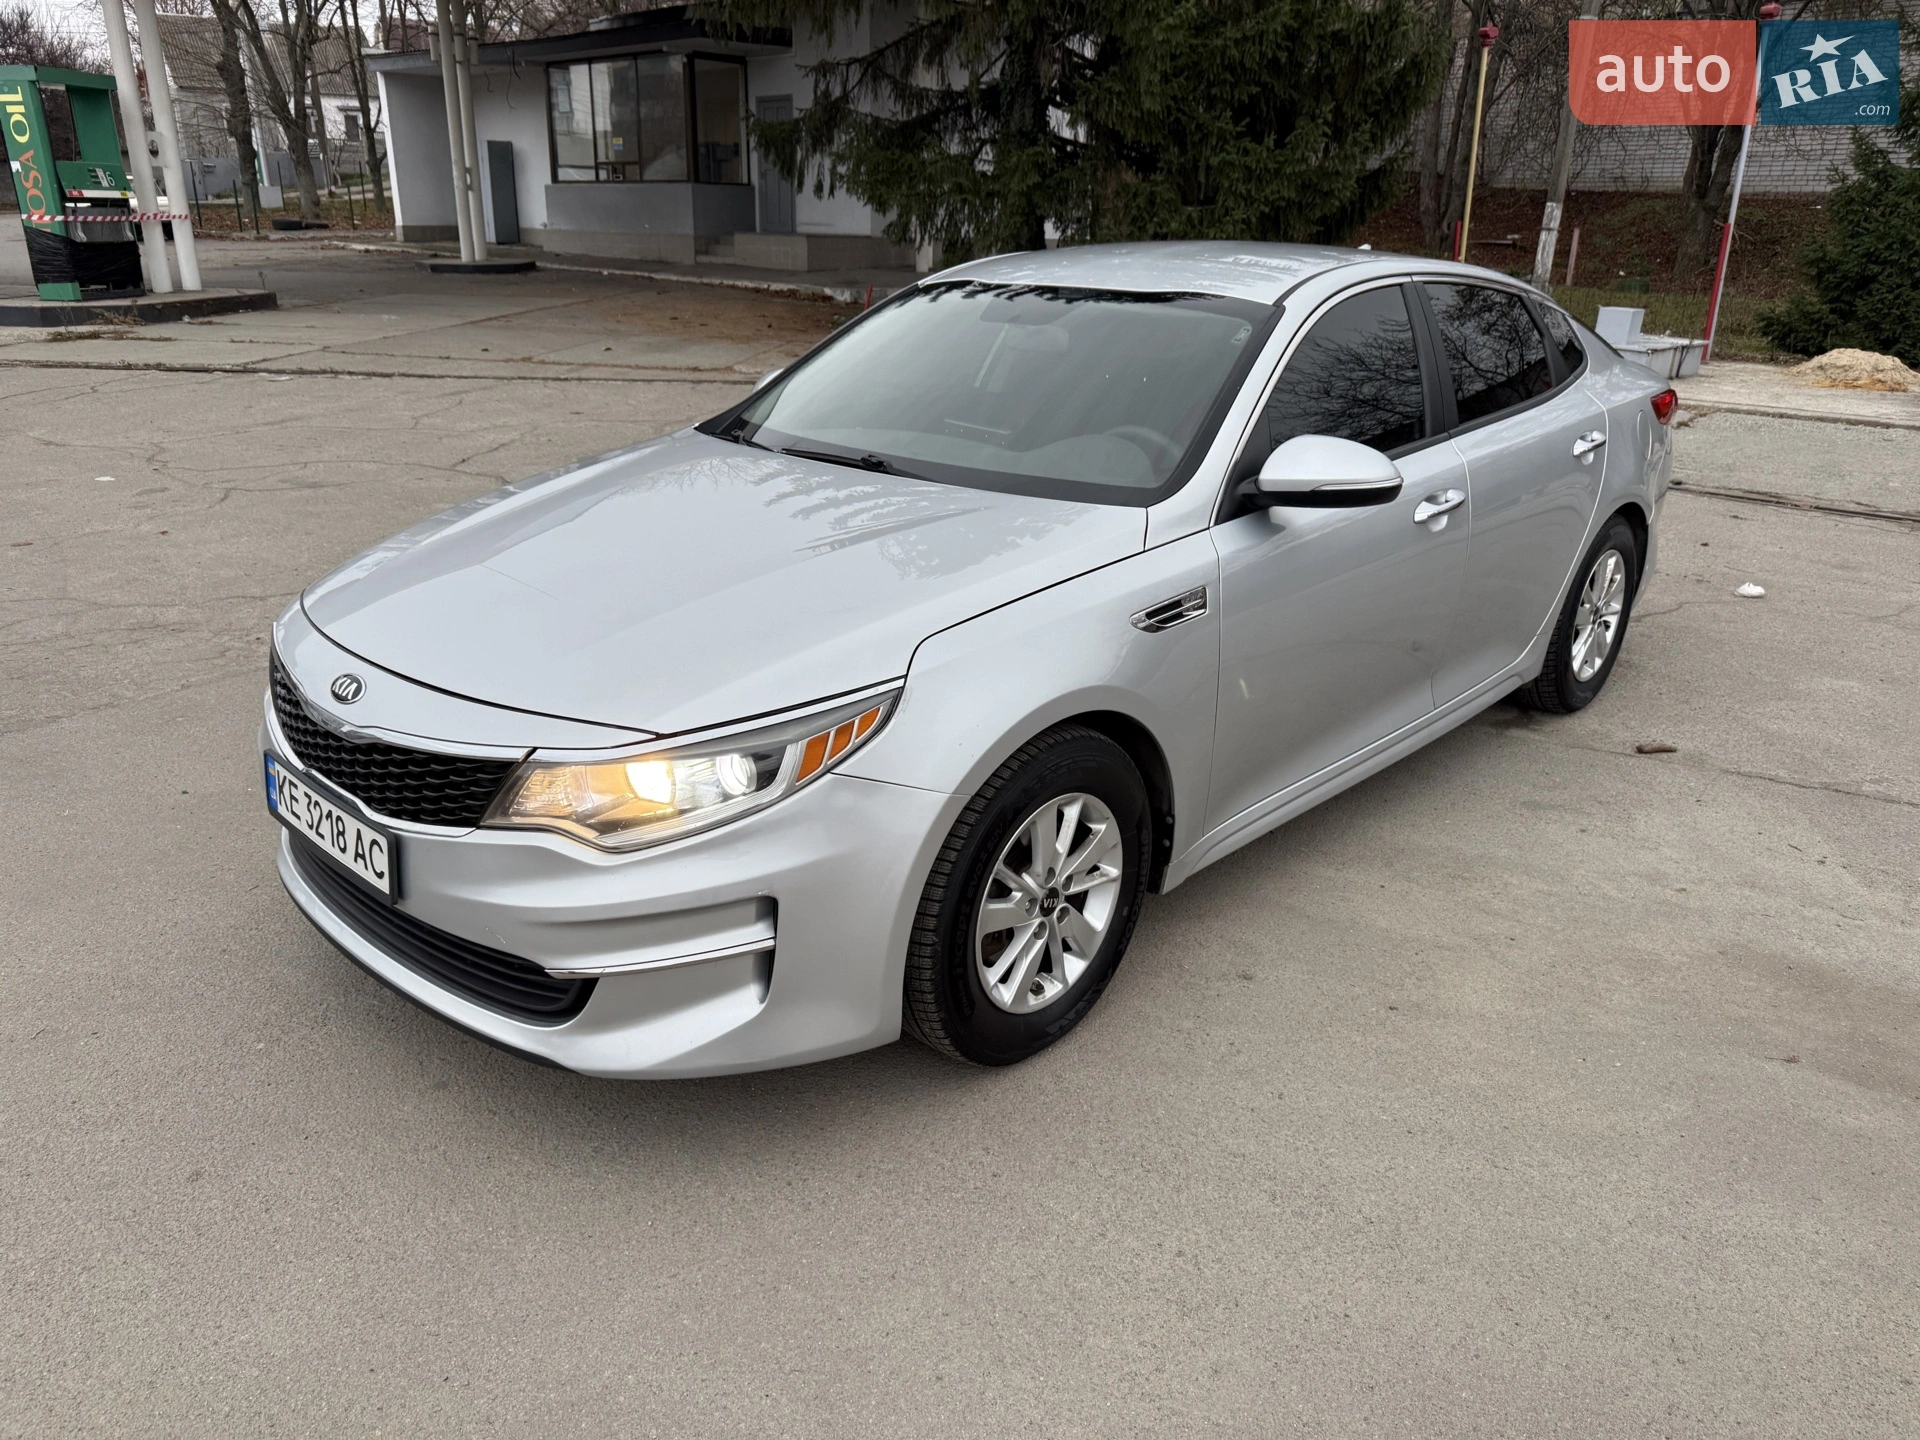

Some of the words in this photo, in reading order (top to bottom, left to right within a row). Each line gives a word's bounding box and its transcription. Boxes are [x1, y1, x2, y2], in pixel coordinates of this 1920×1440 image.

[0, 85, 31, 144] OIL
[332, 676, 359, 700] KIA
[276, 769, 301, 822] KE
[303, 790, 347, 855] 3218
[353, 827, 385, 880] AC
